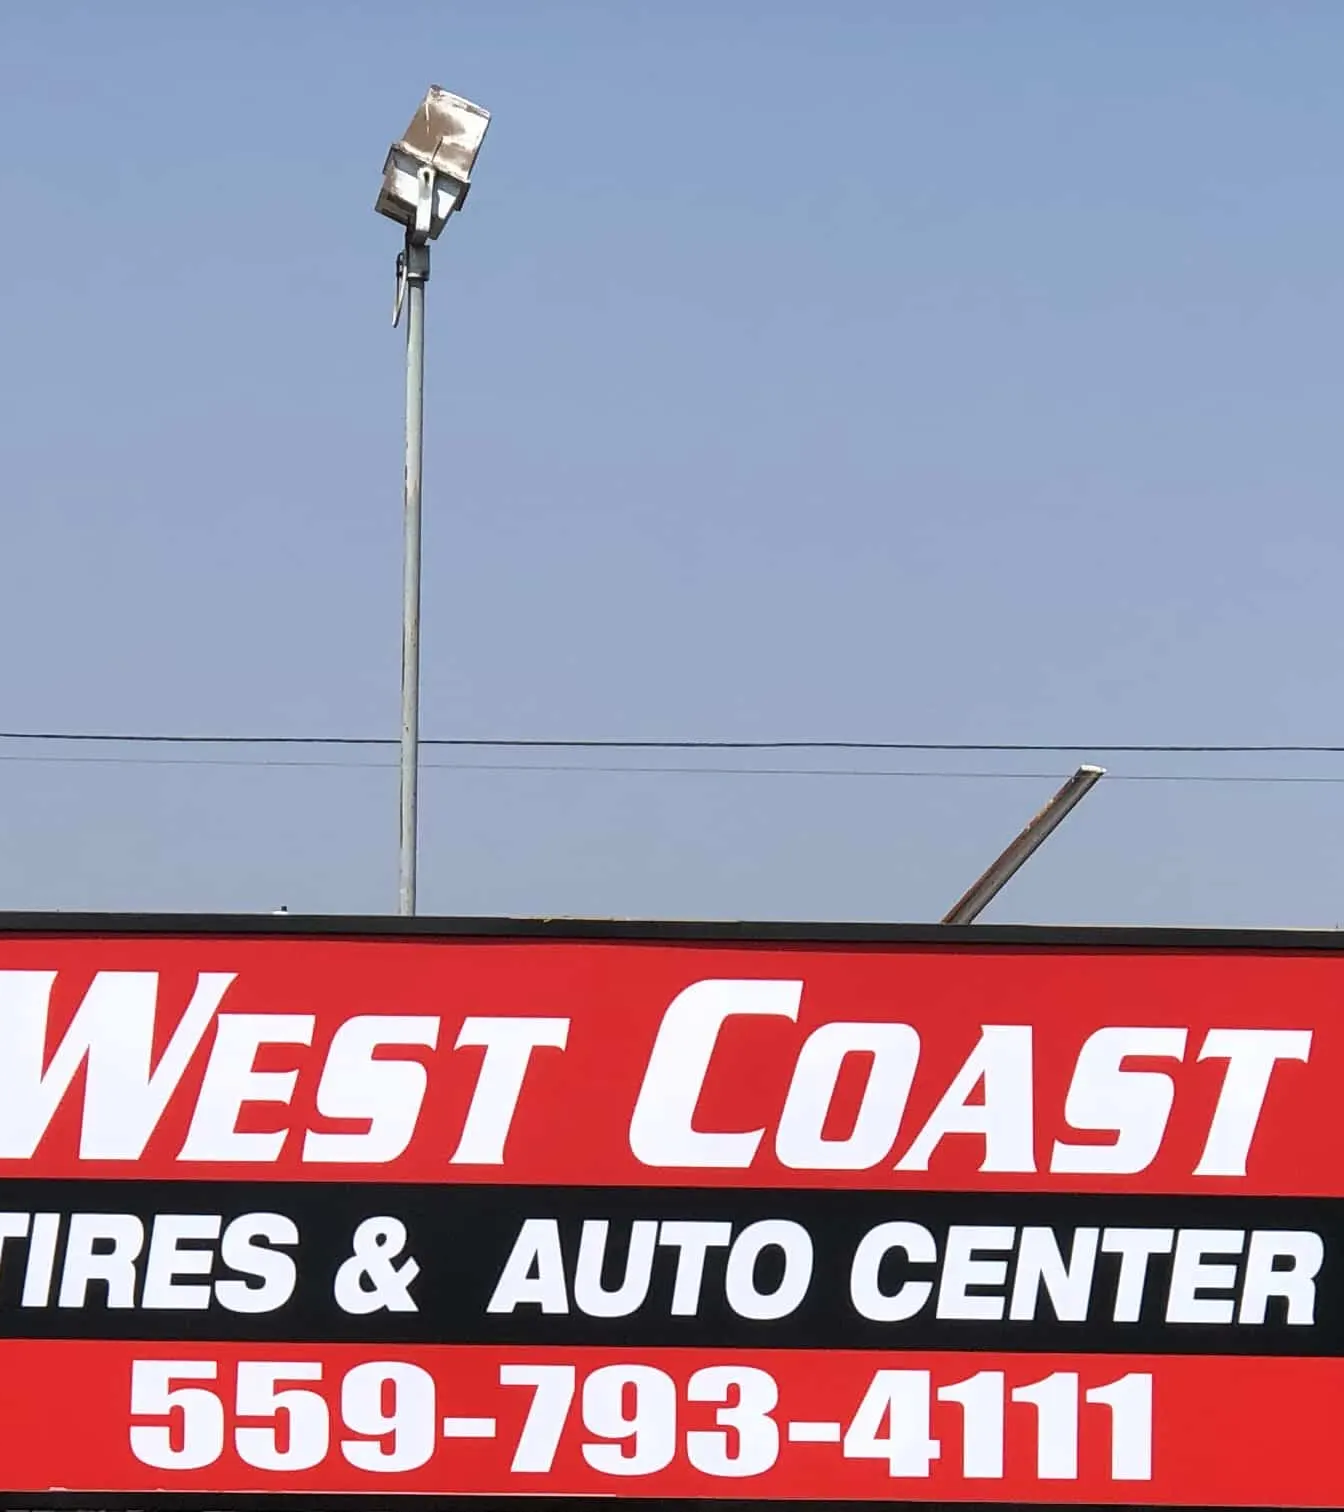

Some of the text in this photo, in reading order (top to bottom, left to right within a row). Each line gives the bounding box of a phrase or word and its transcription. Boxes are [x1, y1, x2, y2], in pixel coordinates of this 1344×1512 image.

[629, 979, 1313, 1177] COAST
[334, 1216, 420, 1315] &
[486, 1218, 814, 1320] AUTO
[850, 1221, 1324, 1326] CENTER
[129, 1359, 1153, 1481] 559-793-4111
